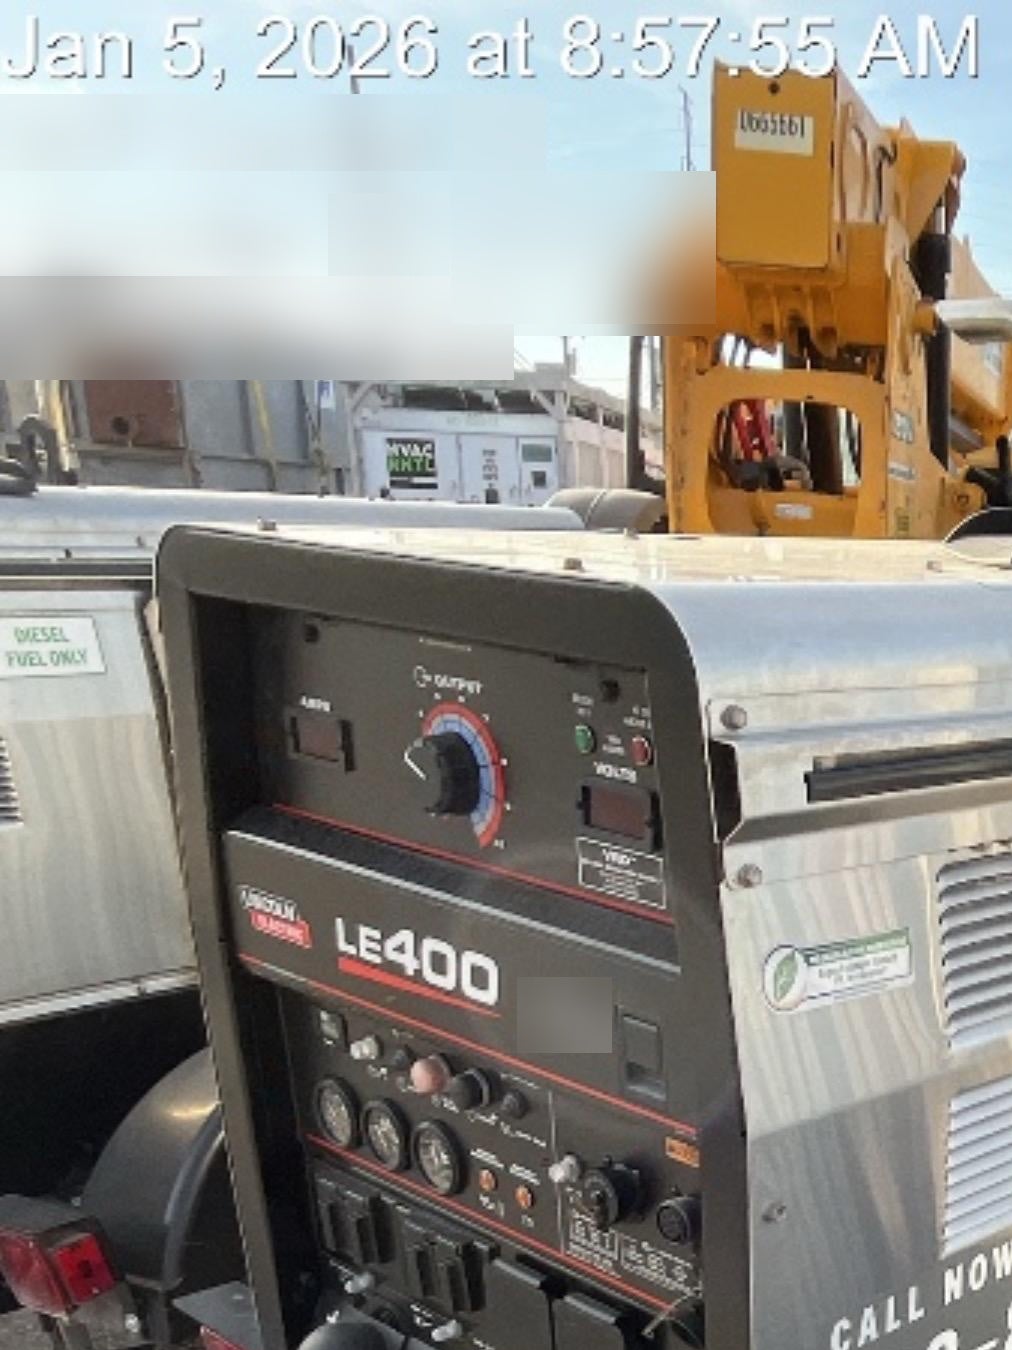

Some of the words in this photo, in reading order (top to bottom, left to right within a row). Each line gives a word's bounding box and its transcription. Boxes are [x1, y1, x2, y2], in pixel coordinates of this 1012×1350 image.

[13, 625, 70, 643] DIESEL
[6, 650, 48, 668] FUEL
[49, 647, 88, 666] ONLY
[335, 917, 500, 1007] LE400
